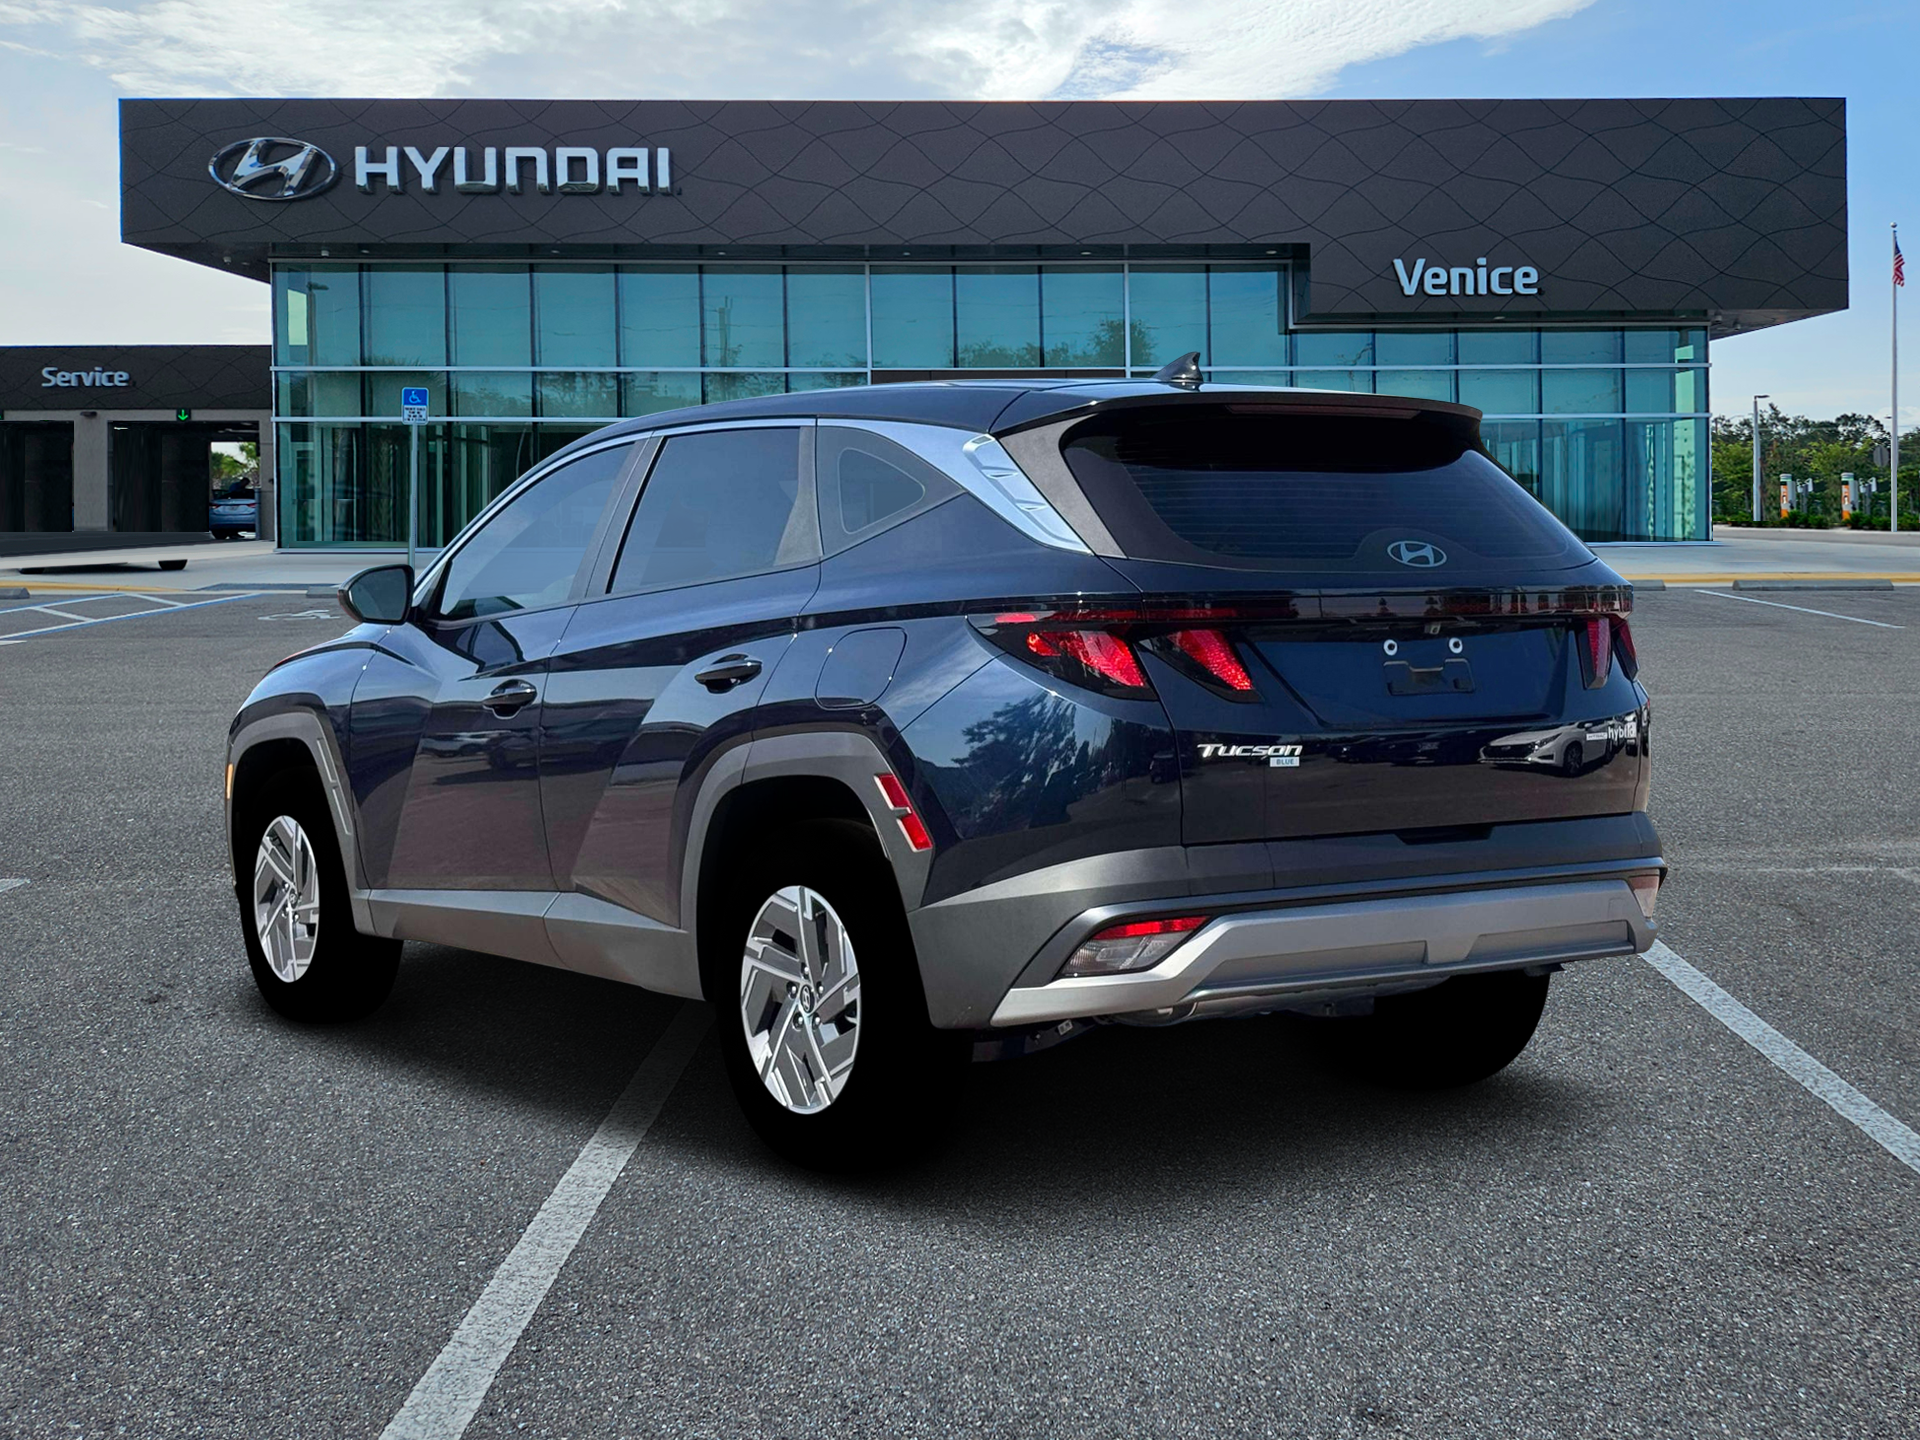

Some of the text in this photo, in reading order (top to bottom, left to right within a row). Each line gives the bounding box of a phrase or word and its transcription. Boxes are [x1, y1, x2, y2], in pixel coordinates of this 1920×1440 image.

[354, 146, 673, 193] HYUNDAI
[1393, 257, 1539, 296] Venice
[41, 366, 130, 388] Service
[1197, 743, 1303, 760] Tucson
